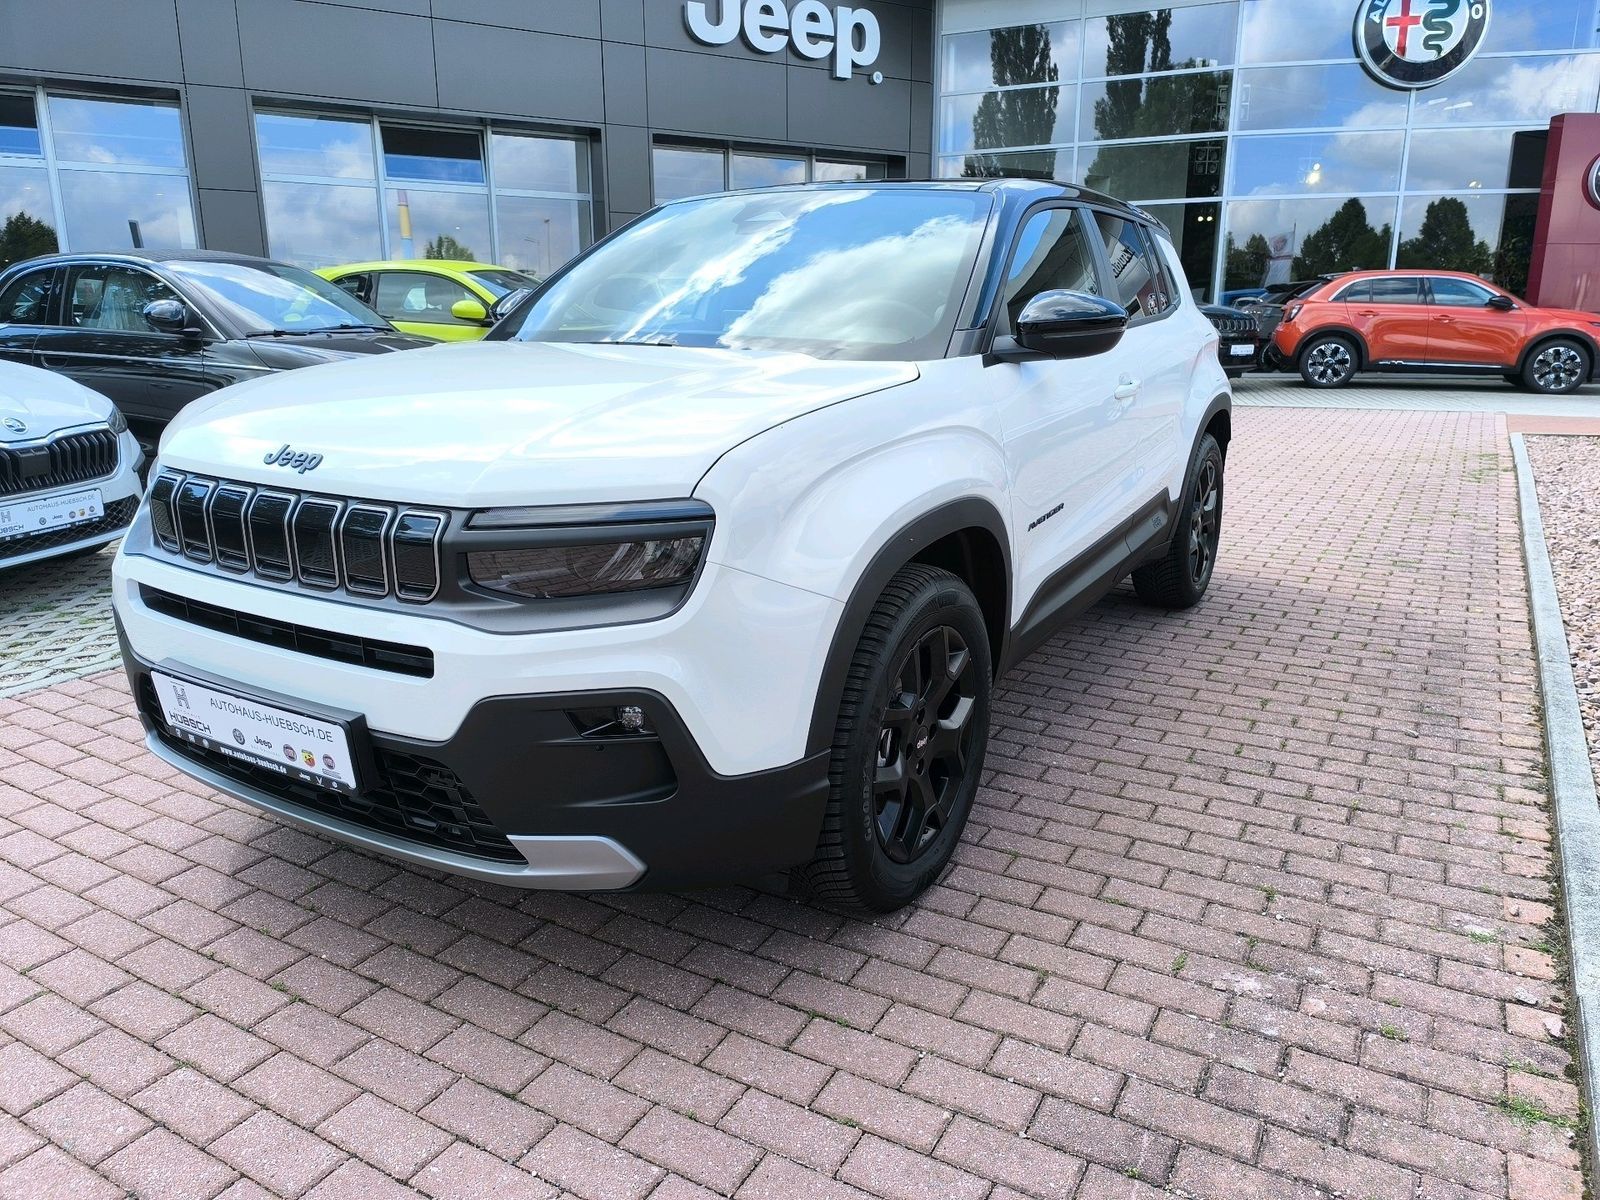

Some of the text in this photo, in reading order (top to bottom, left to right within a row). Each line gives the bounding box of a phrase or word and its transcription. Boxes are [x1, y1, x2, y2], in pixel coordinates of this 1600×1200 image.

[686, 0, 881, 79] Jeep
[263, 443, 324, 474] Jeep
[210, 697, 334, 742] AUTOHAUS-HUEBSCH.DE
[253, 735, 273, 750] Jeep
